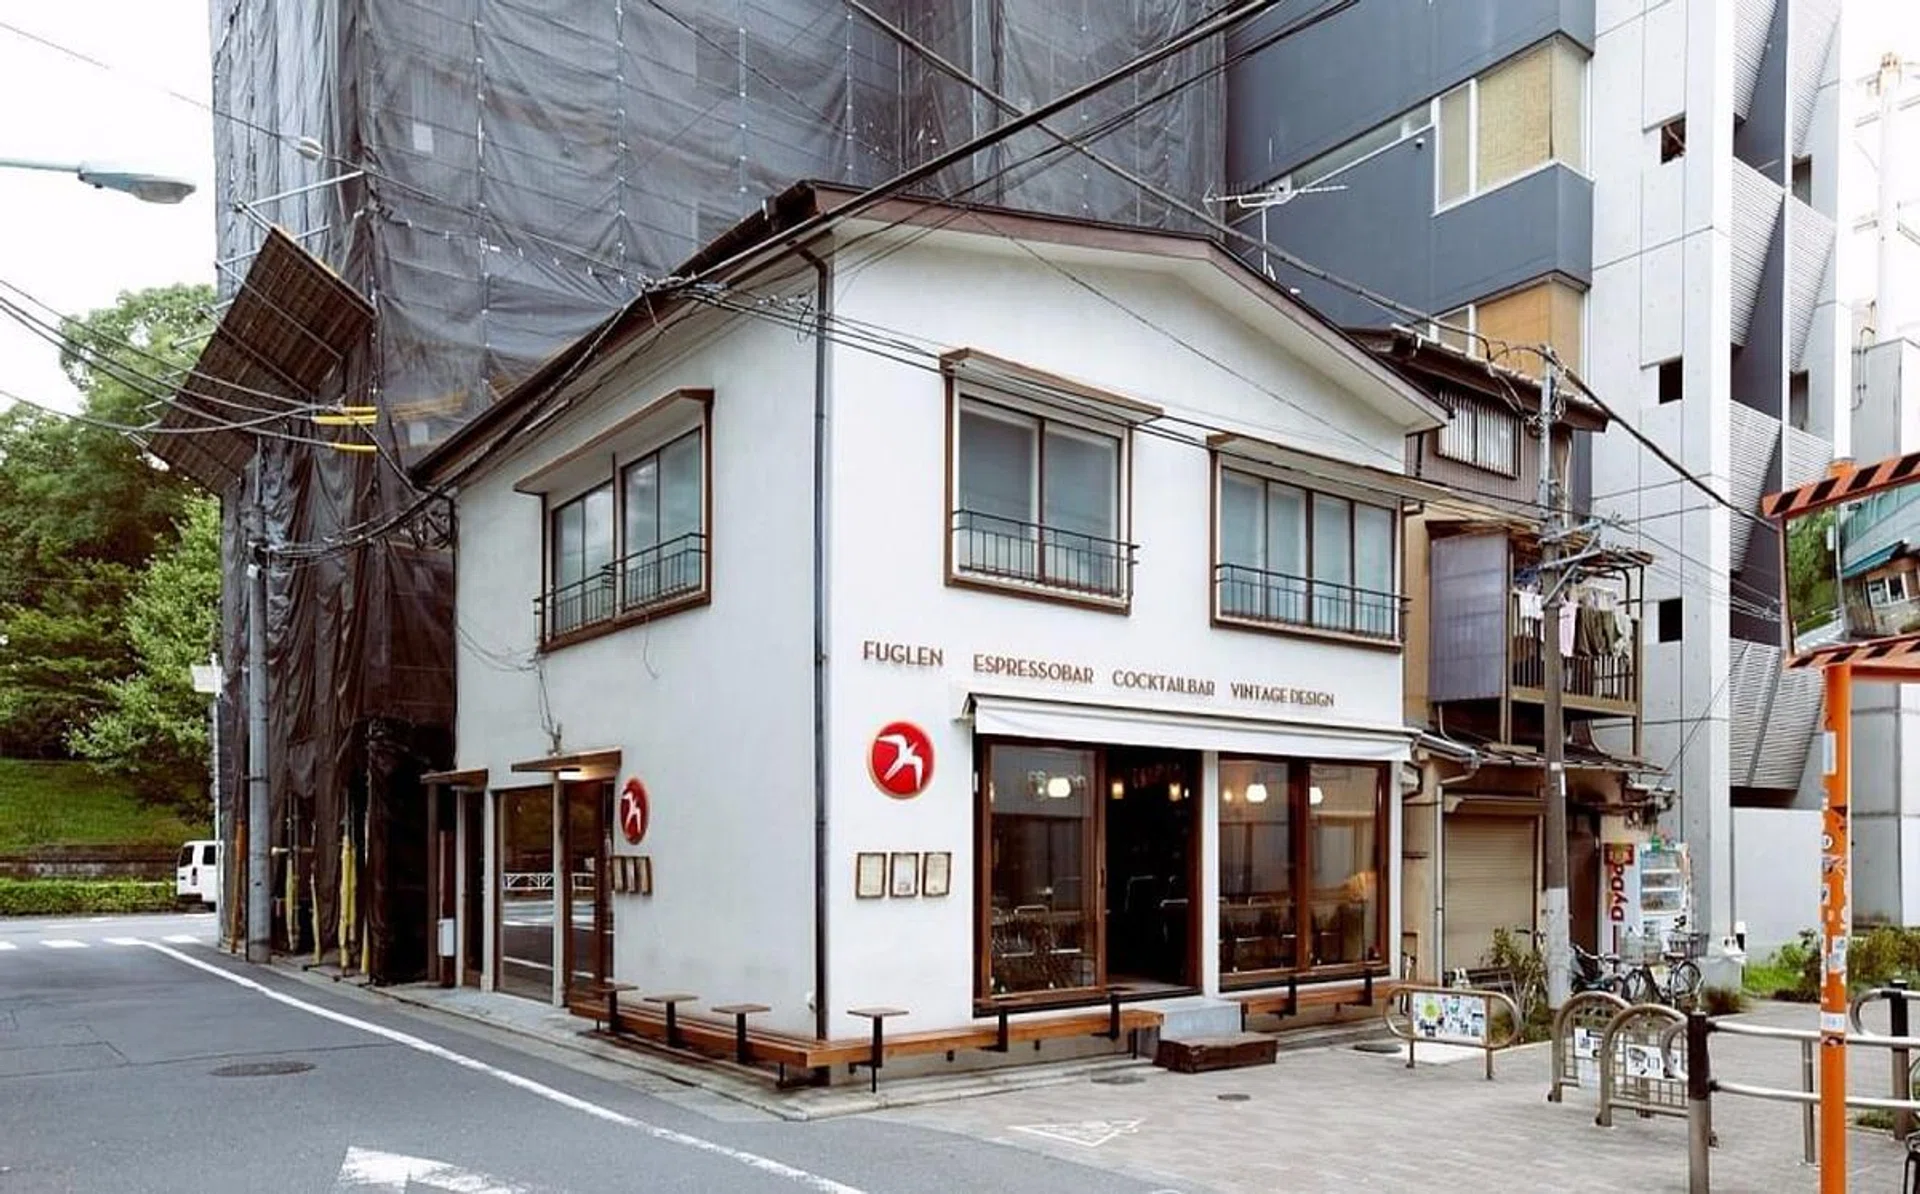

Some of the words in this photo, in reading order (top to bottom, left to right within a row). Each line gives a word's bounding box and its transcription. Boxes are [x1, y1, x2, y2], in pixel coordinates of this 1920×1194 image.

[863, 641, 944, 667] FUGLEN
[973, 654, 1094, 685] ESPRESSOBAR
[1112, 669, 1215, 697] COCKTAILBAR
[1230, 682, 1289, 705] VINTAGE
[1290, 688, 1335, 708] DESIGN
